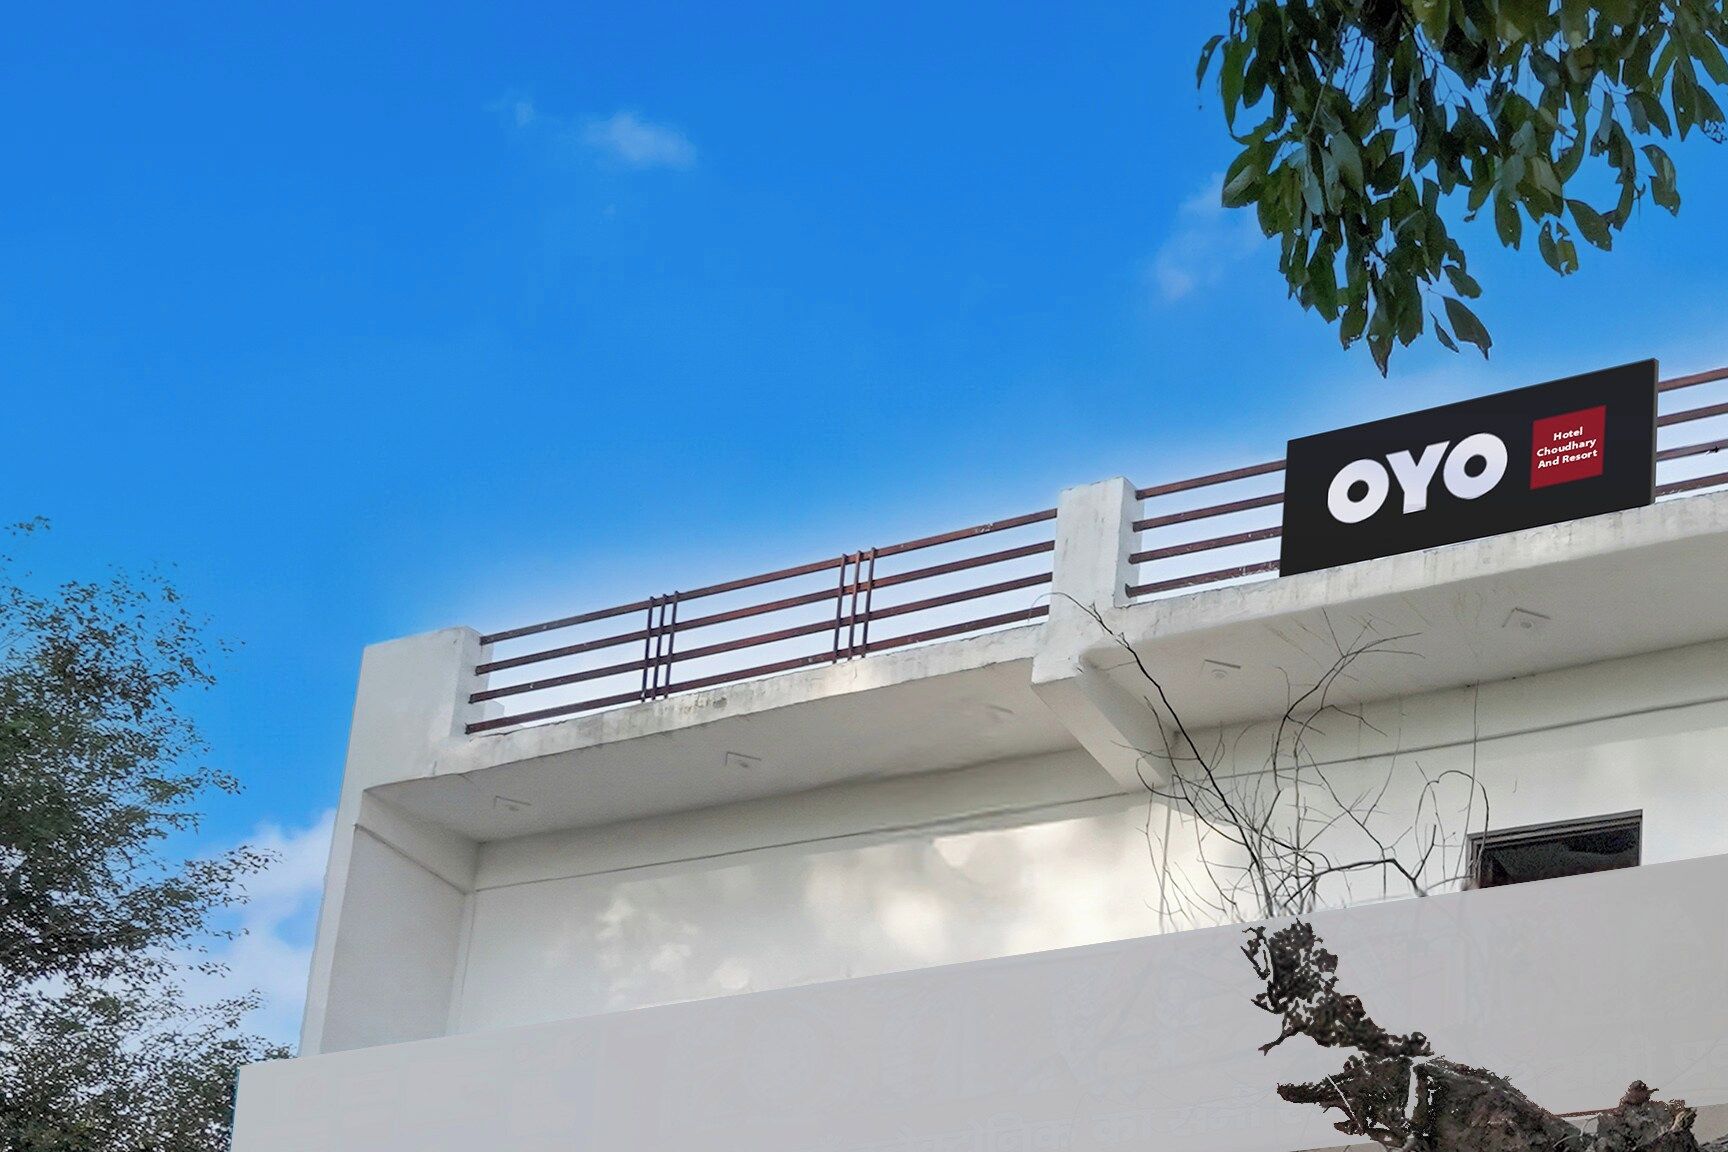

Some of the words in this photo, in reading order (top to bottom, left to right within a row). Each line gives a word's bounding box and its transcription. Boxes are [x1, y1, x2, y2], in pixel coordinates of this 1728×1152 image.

[1554, 426, 1583, 441] Hotel
[1537, 439, 1597, 457] Choudhary
[1538, 455, 1559, 468] And
[1562, 450, 1598, 463] Resort
[1327, 432, 1508, 524] OYO
